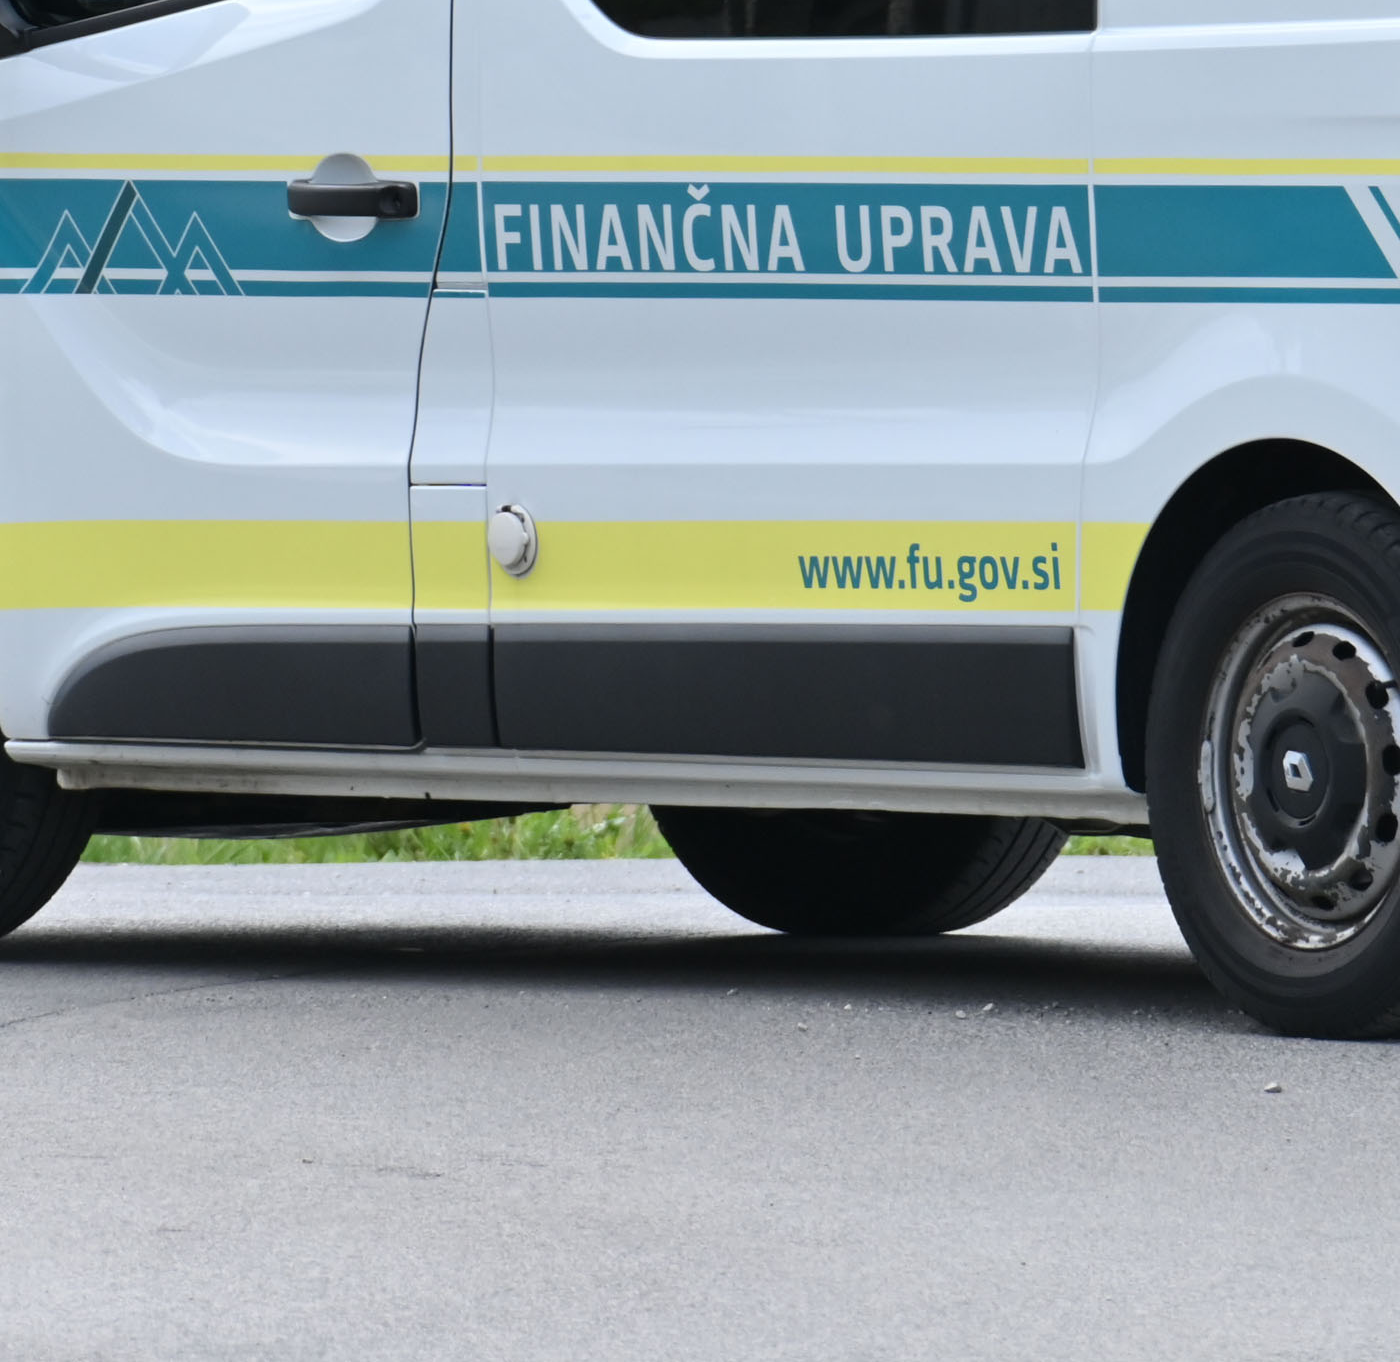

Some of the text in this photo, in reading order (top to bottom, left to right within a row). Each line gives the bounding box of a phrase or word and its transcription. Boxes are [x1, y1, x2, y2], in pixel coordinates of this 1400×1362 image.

[492, 183, 1085, 275] FINANČNA UPRAVA
[798, 542, 1062, 603] www.fu.gov.si
